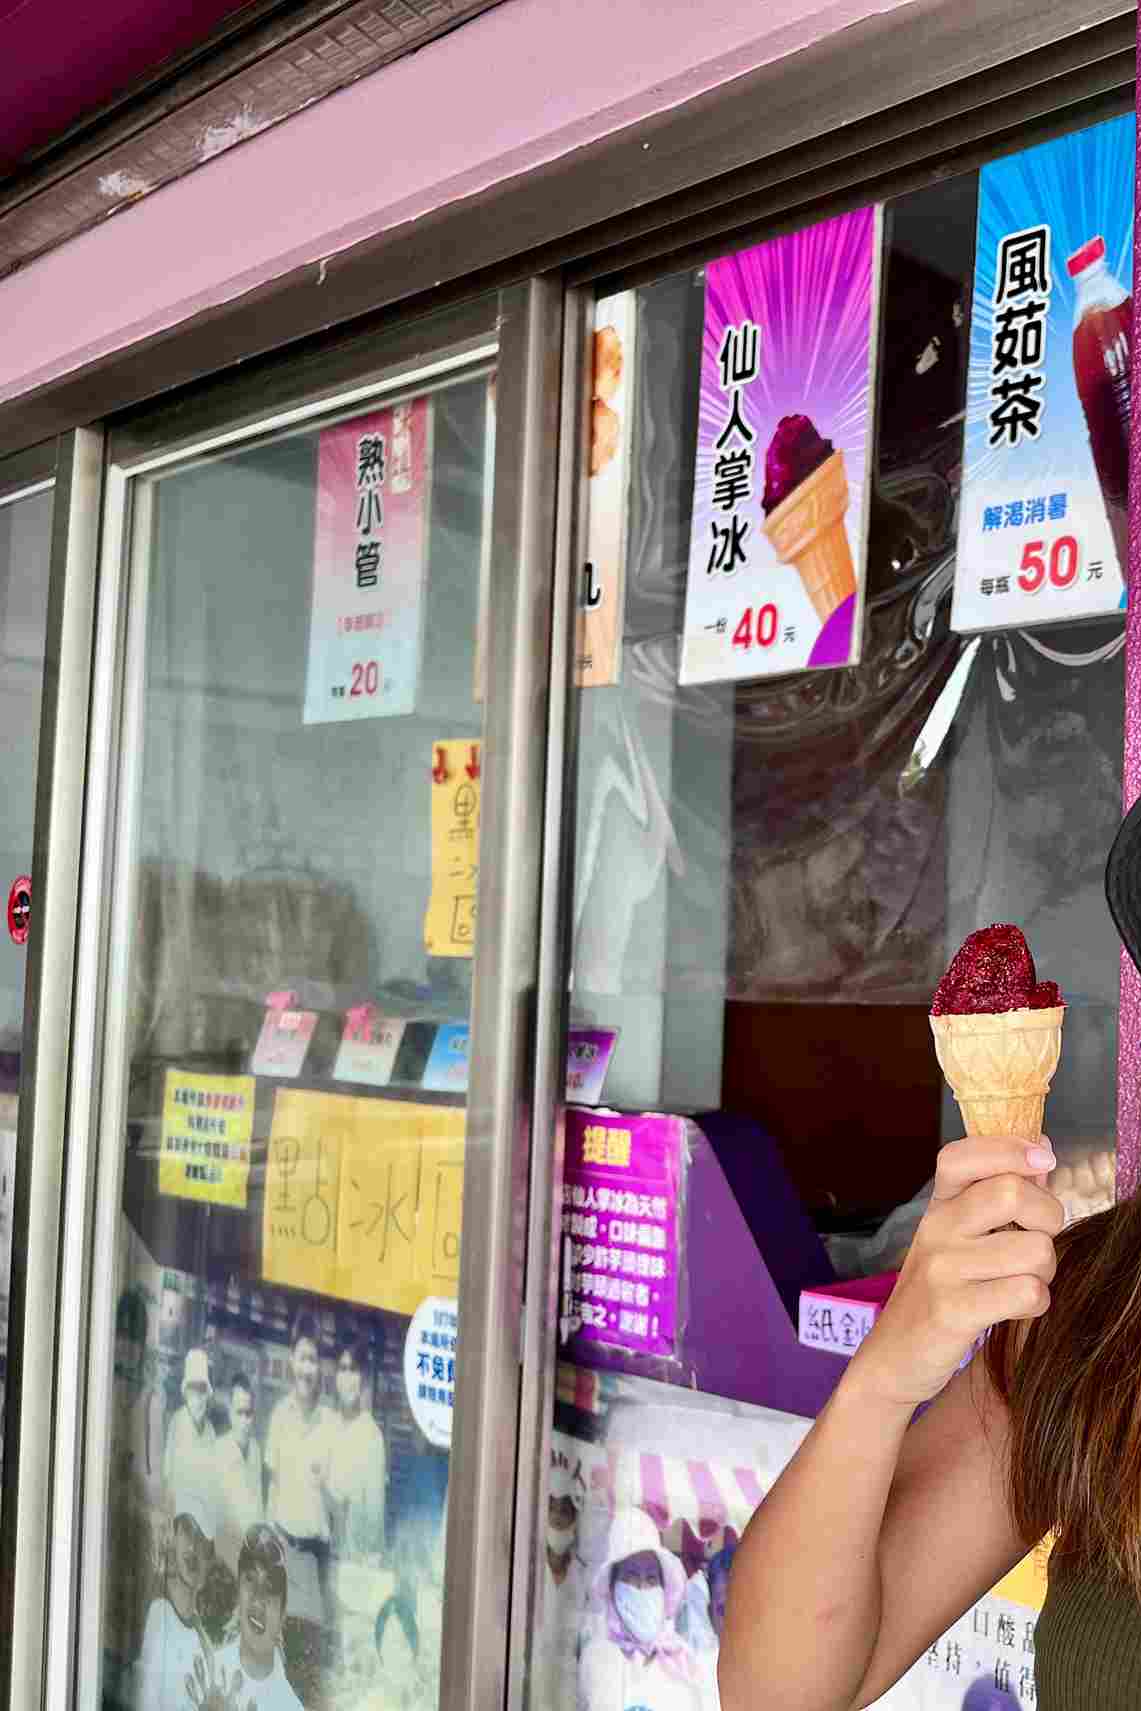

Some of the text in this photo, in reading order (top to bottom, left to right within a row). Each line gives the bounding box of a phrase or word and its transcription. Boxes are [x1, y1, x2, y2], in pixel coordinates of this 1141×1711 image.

[988, 228, 1048, 446] 風茹茶
[706, 325, 759, 575] 仙人掌冰
[982, 493, 1067, 531] 解渴消暑
[1017, 535, 1079, 593] 50
[1087, 560, 1104, 581] 元
[732, 603, 779, 650] 40
[350, 660, 378, 697] 20
